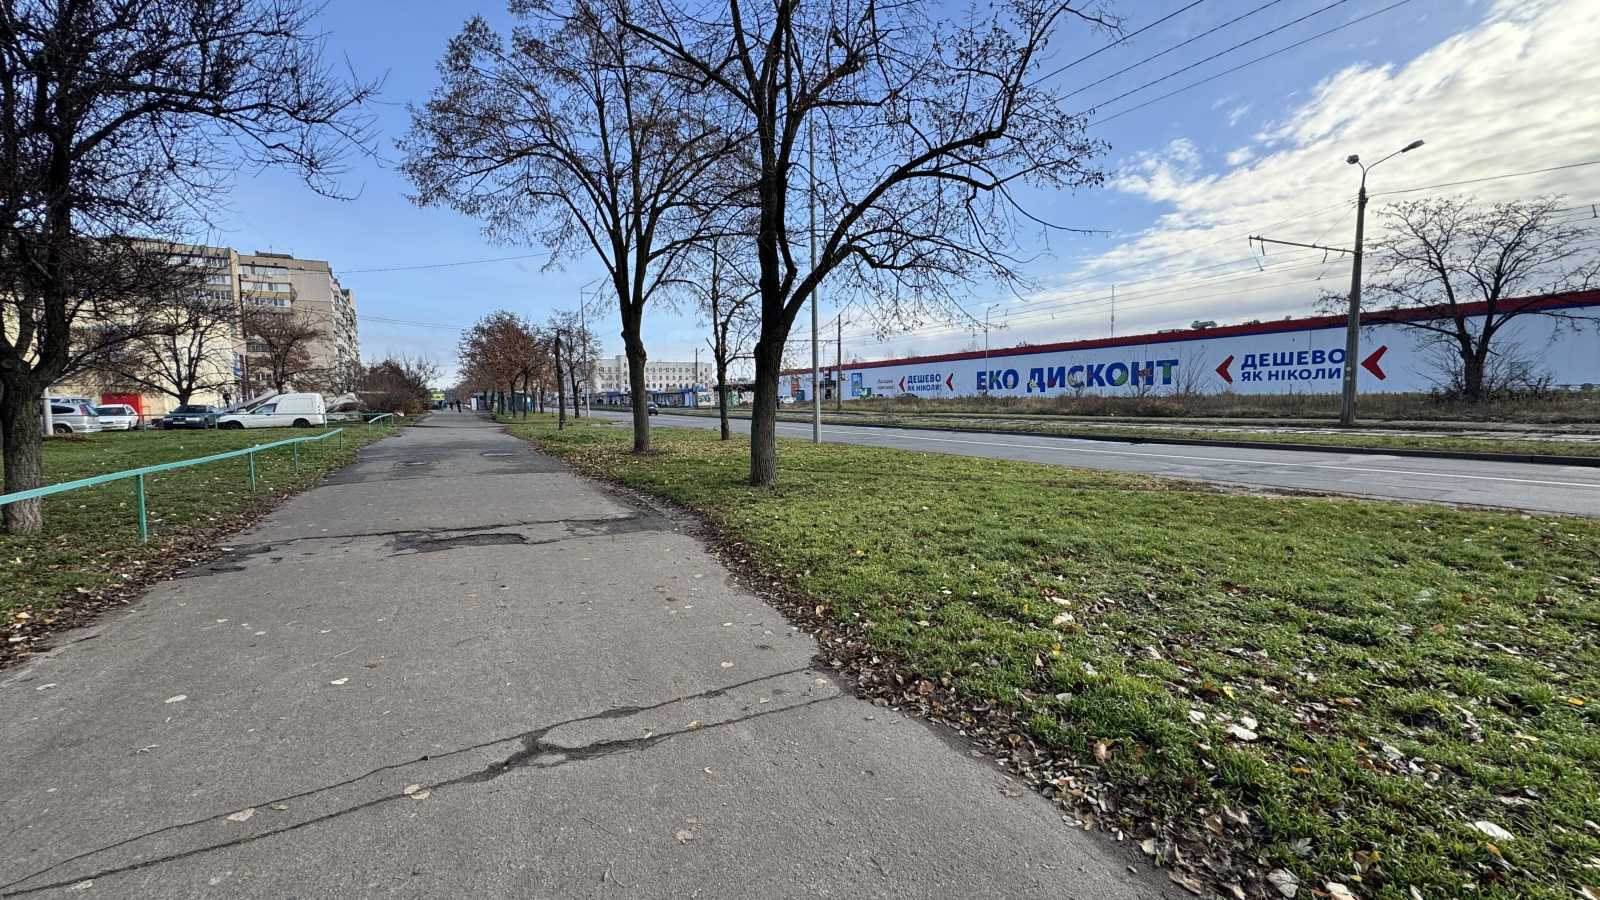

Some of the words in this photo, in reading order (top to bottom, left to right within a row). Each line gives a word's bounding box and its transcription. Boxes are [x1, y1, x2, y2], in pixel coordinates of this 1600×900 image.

[1241, 348, 1345, 371] ДЕШЕВО
[907, 374, 941, 385] ДЕШЕВО
[976, 368, 1019, 390] ЕКО
[1026, 359, 1179, 393] ДИСКОНТ
[1241, 370, 1262, 382] ЯК
